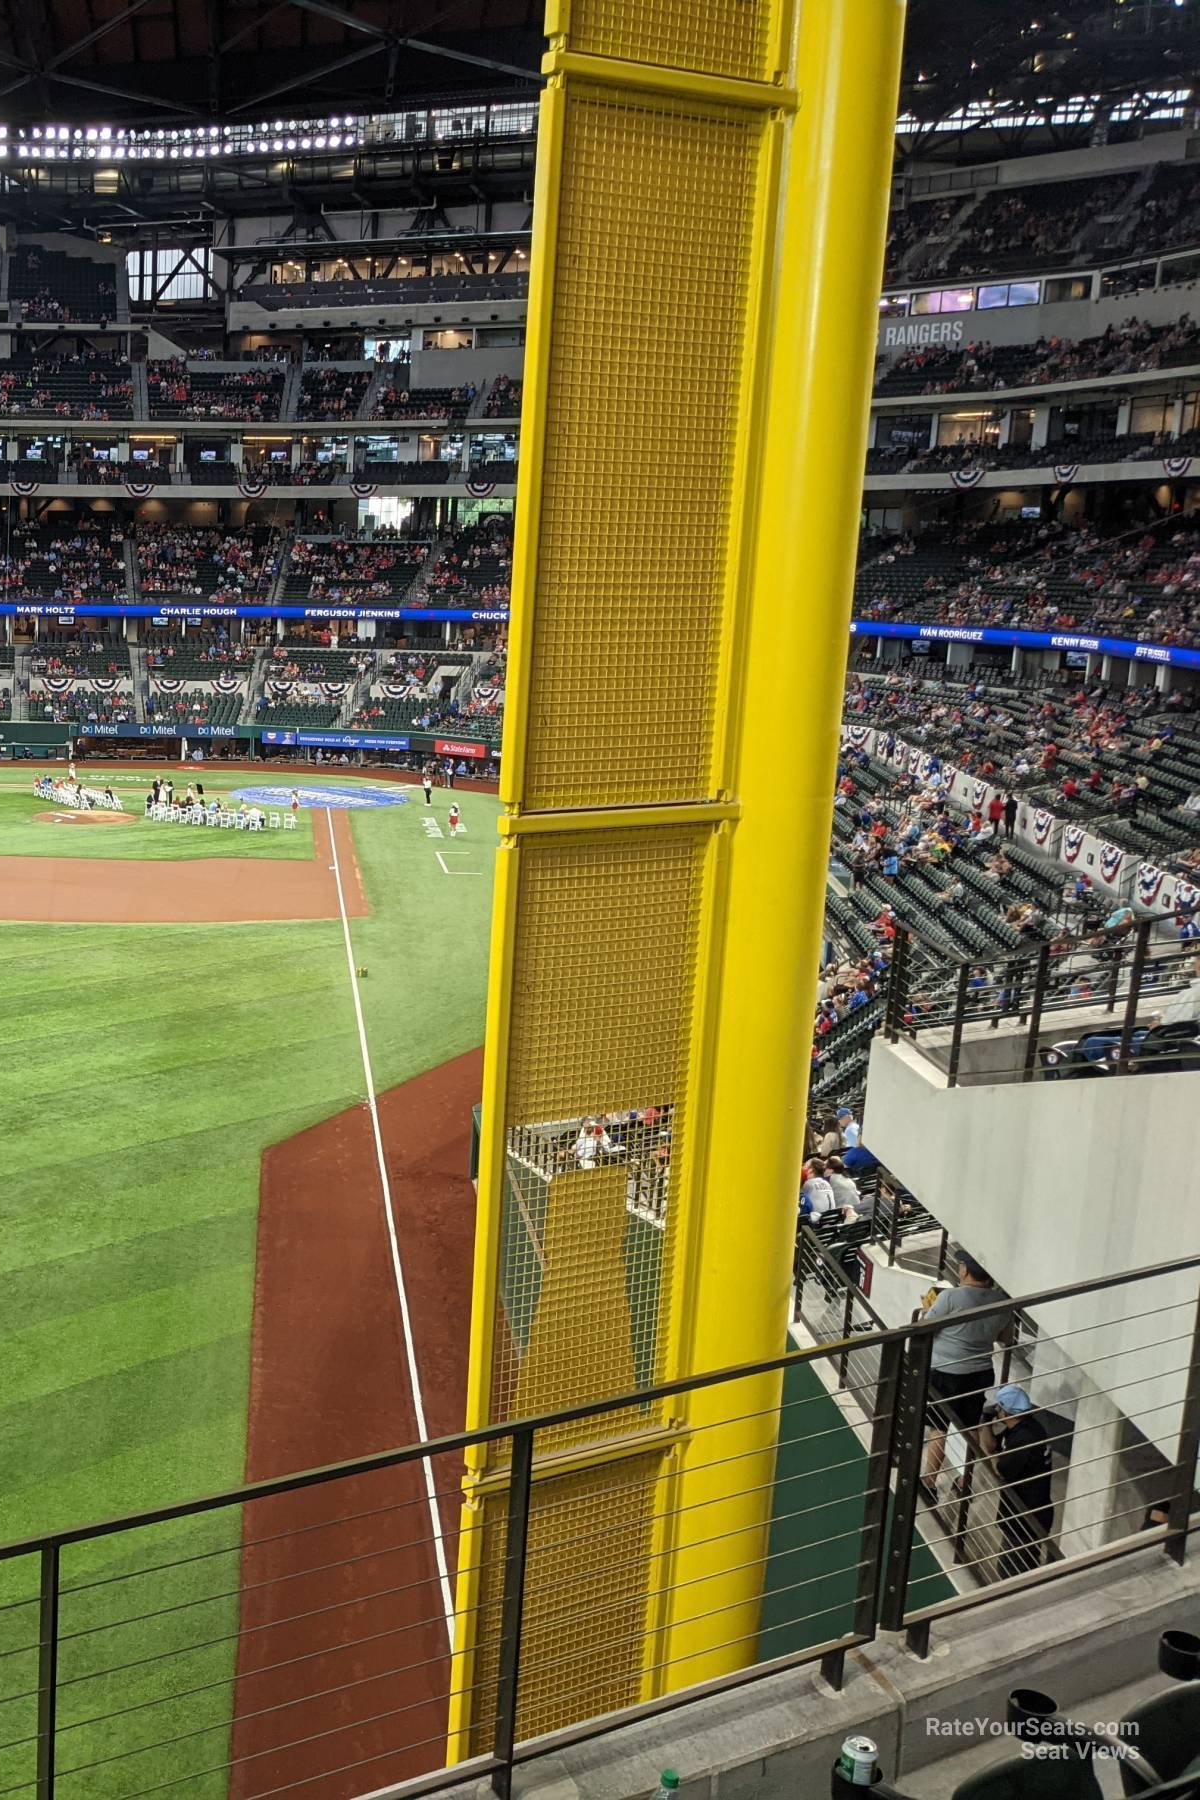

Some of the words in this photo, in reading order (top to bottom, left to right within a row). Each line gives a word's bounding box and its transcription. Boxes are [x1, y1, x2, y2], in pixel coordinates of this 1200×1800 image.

[885, 321, 963, 346] RANGERS
[16, 606, 44, 614] MARK
[45, 606, 76, 615] HOLTZ
[159, 607, 202, 616] CHARLIE
[202, 607, 237, 617] HOUGH
[304, 608, 356, 617] FERGUSON
[472, 611, 508, 620] CHUCK
[94, 724, 119, 735] Mitel
[152, 725, 177, 736] Mitel
[211, 726, 235, 736] Mitel
